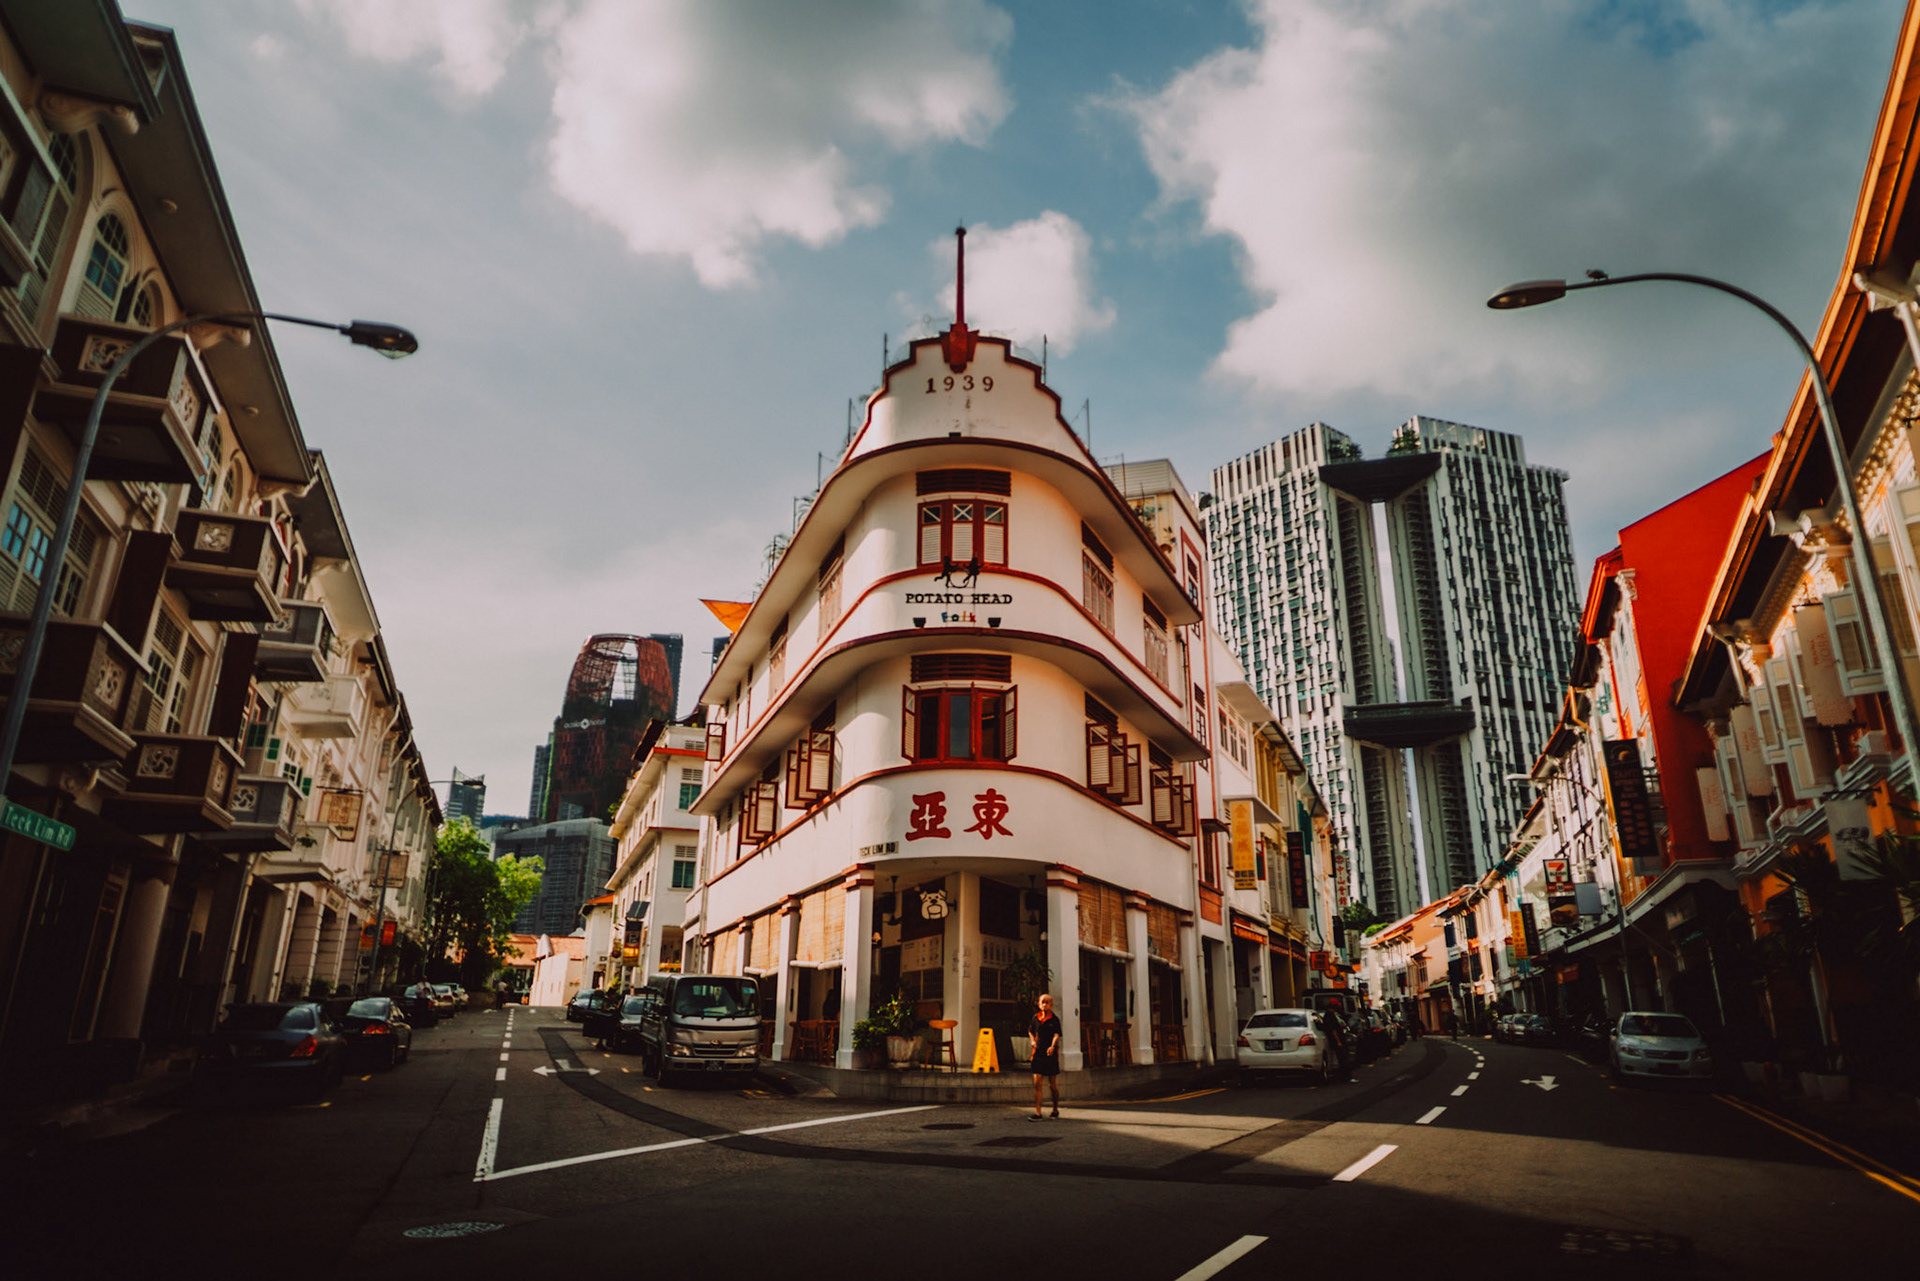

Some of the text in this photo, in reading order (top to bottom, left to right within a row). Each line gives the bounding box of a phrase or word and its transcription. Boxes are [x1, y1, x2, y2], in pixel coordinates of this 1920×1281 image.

[926, 375, 994, 394] 1939
[905, 593, 1013, 605] POTATO HEAD
[905, 788, 1013, 841] 亞東
[5, 806, 72, 847] Teck Lim Rd
[872, 844, 883, 855] LIM
[886, 842, 895, 853] RD
